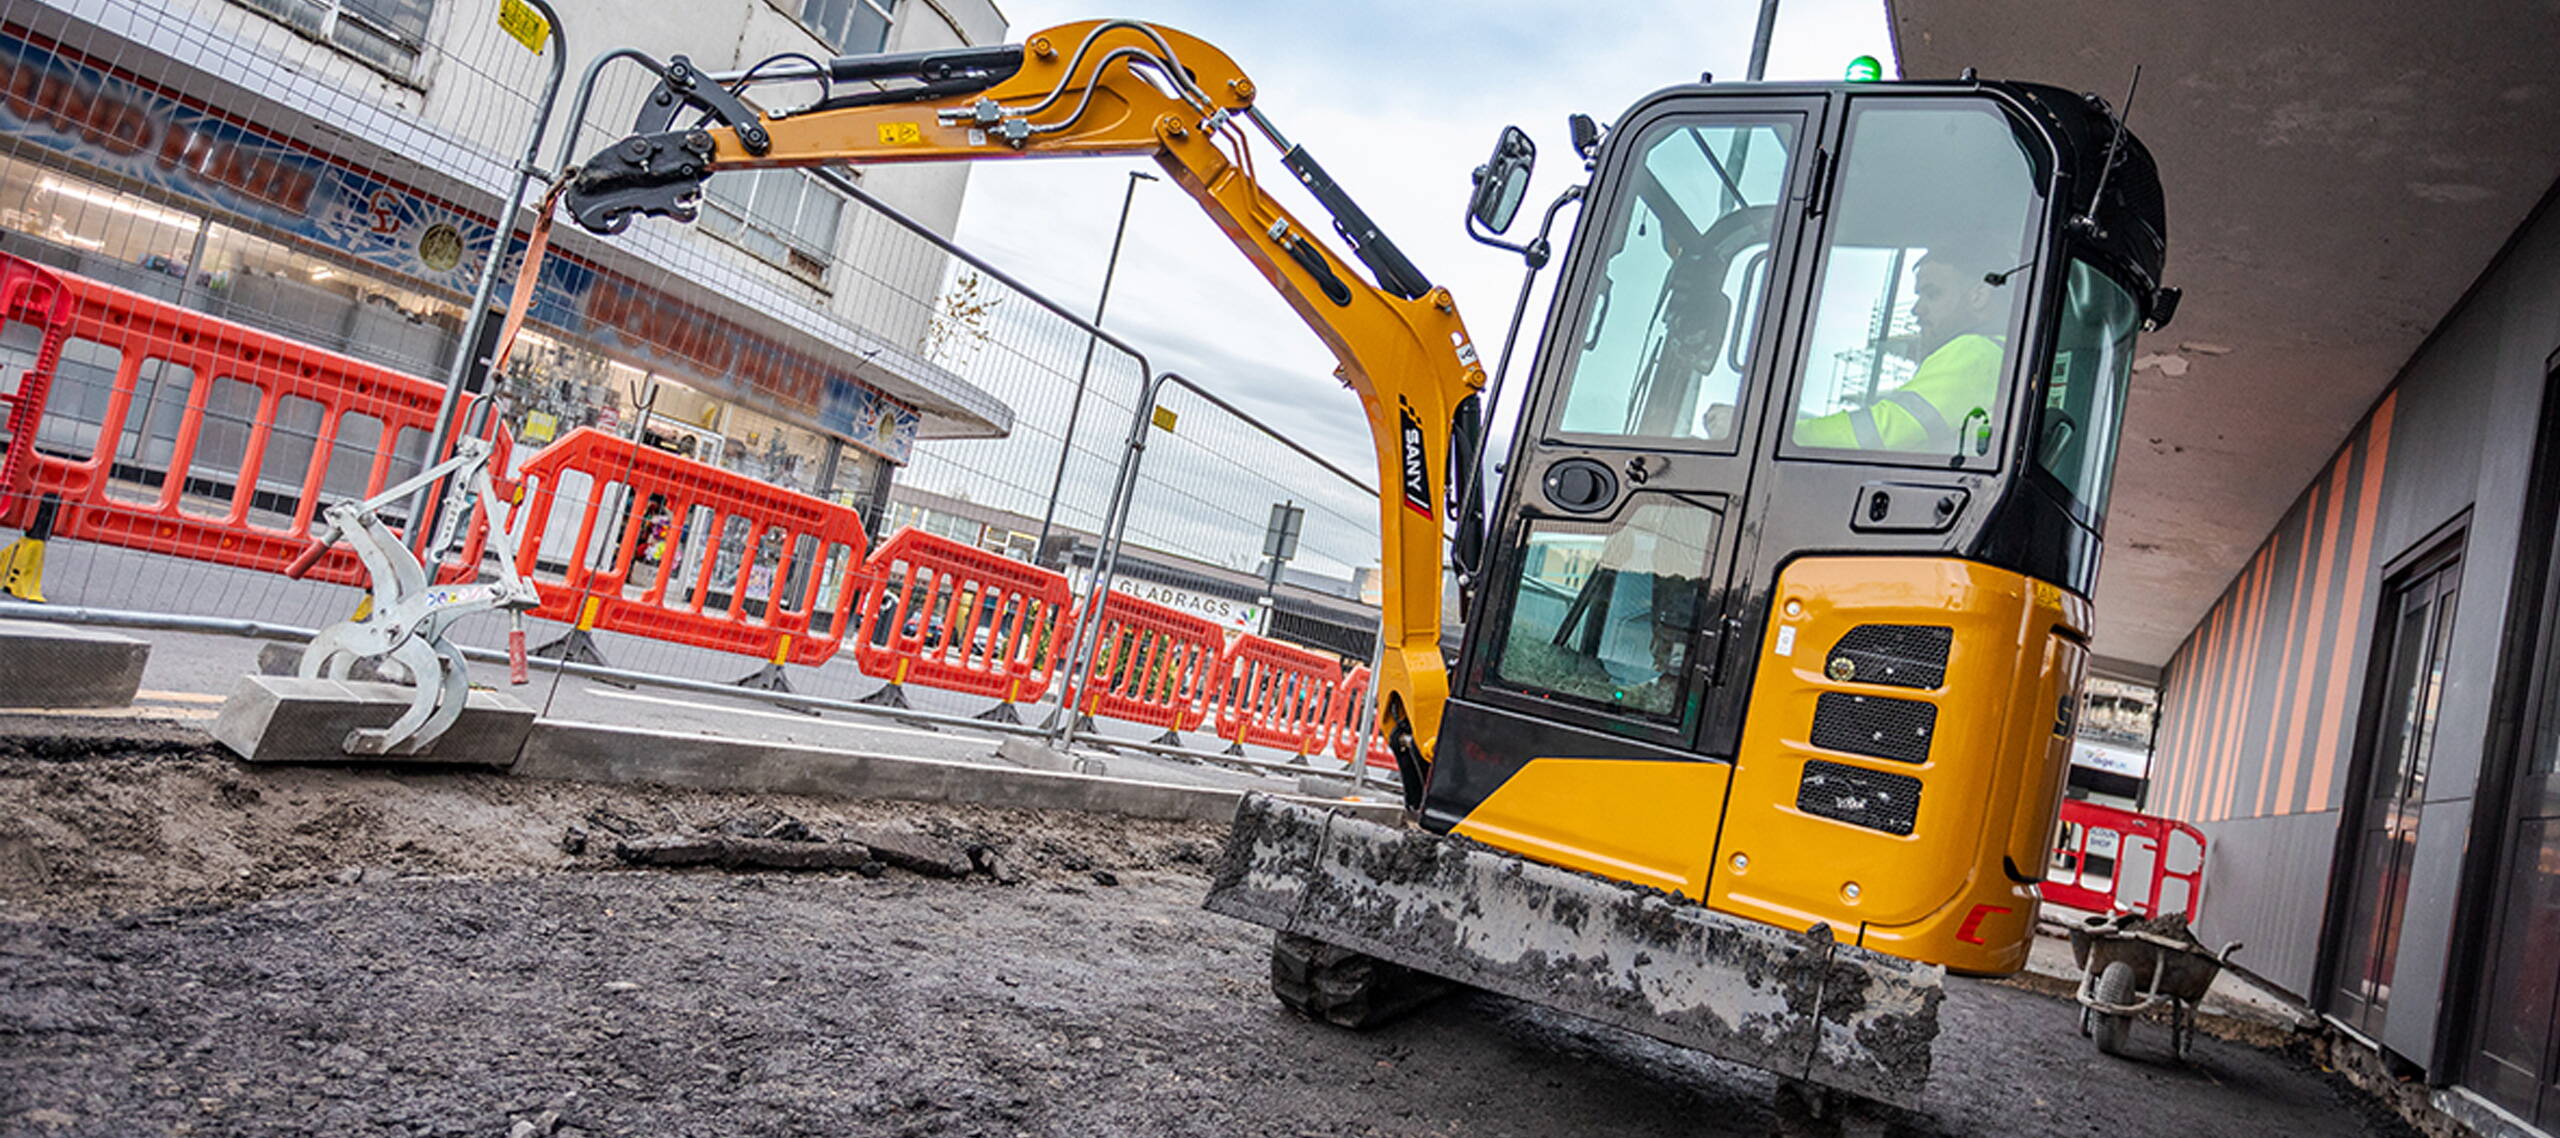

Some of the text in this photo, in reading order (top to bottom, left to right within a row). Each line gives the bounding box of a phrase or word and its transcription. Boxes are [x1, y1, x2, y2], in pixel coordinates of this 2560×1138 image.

[1404, 428, 1422, 492] SANY
[1118, 579, 1231, 617] GLADRAGS
[2090, 837, 2112, 848] SHOP
